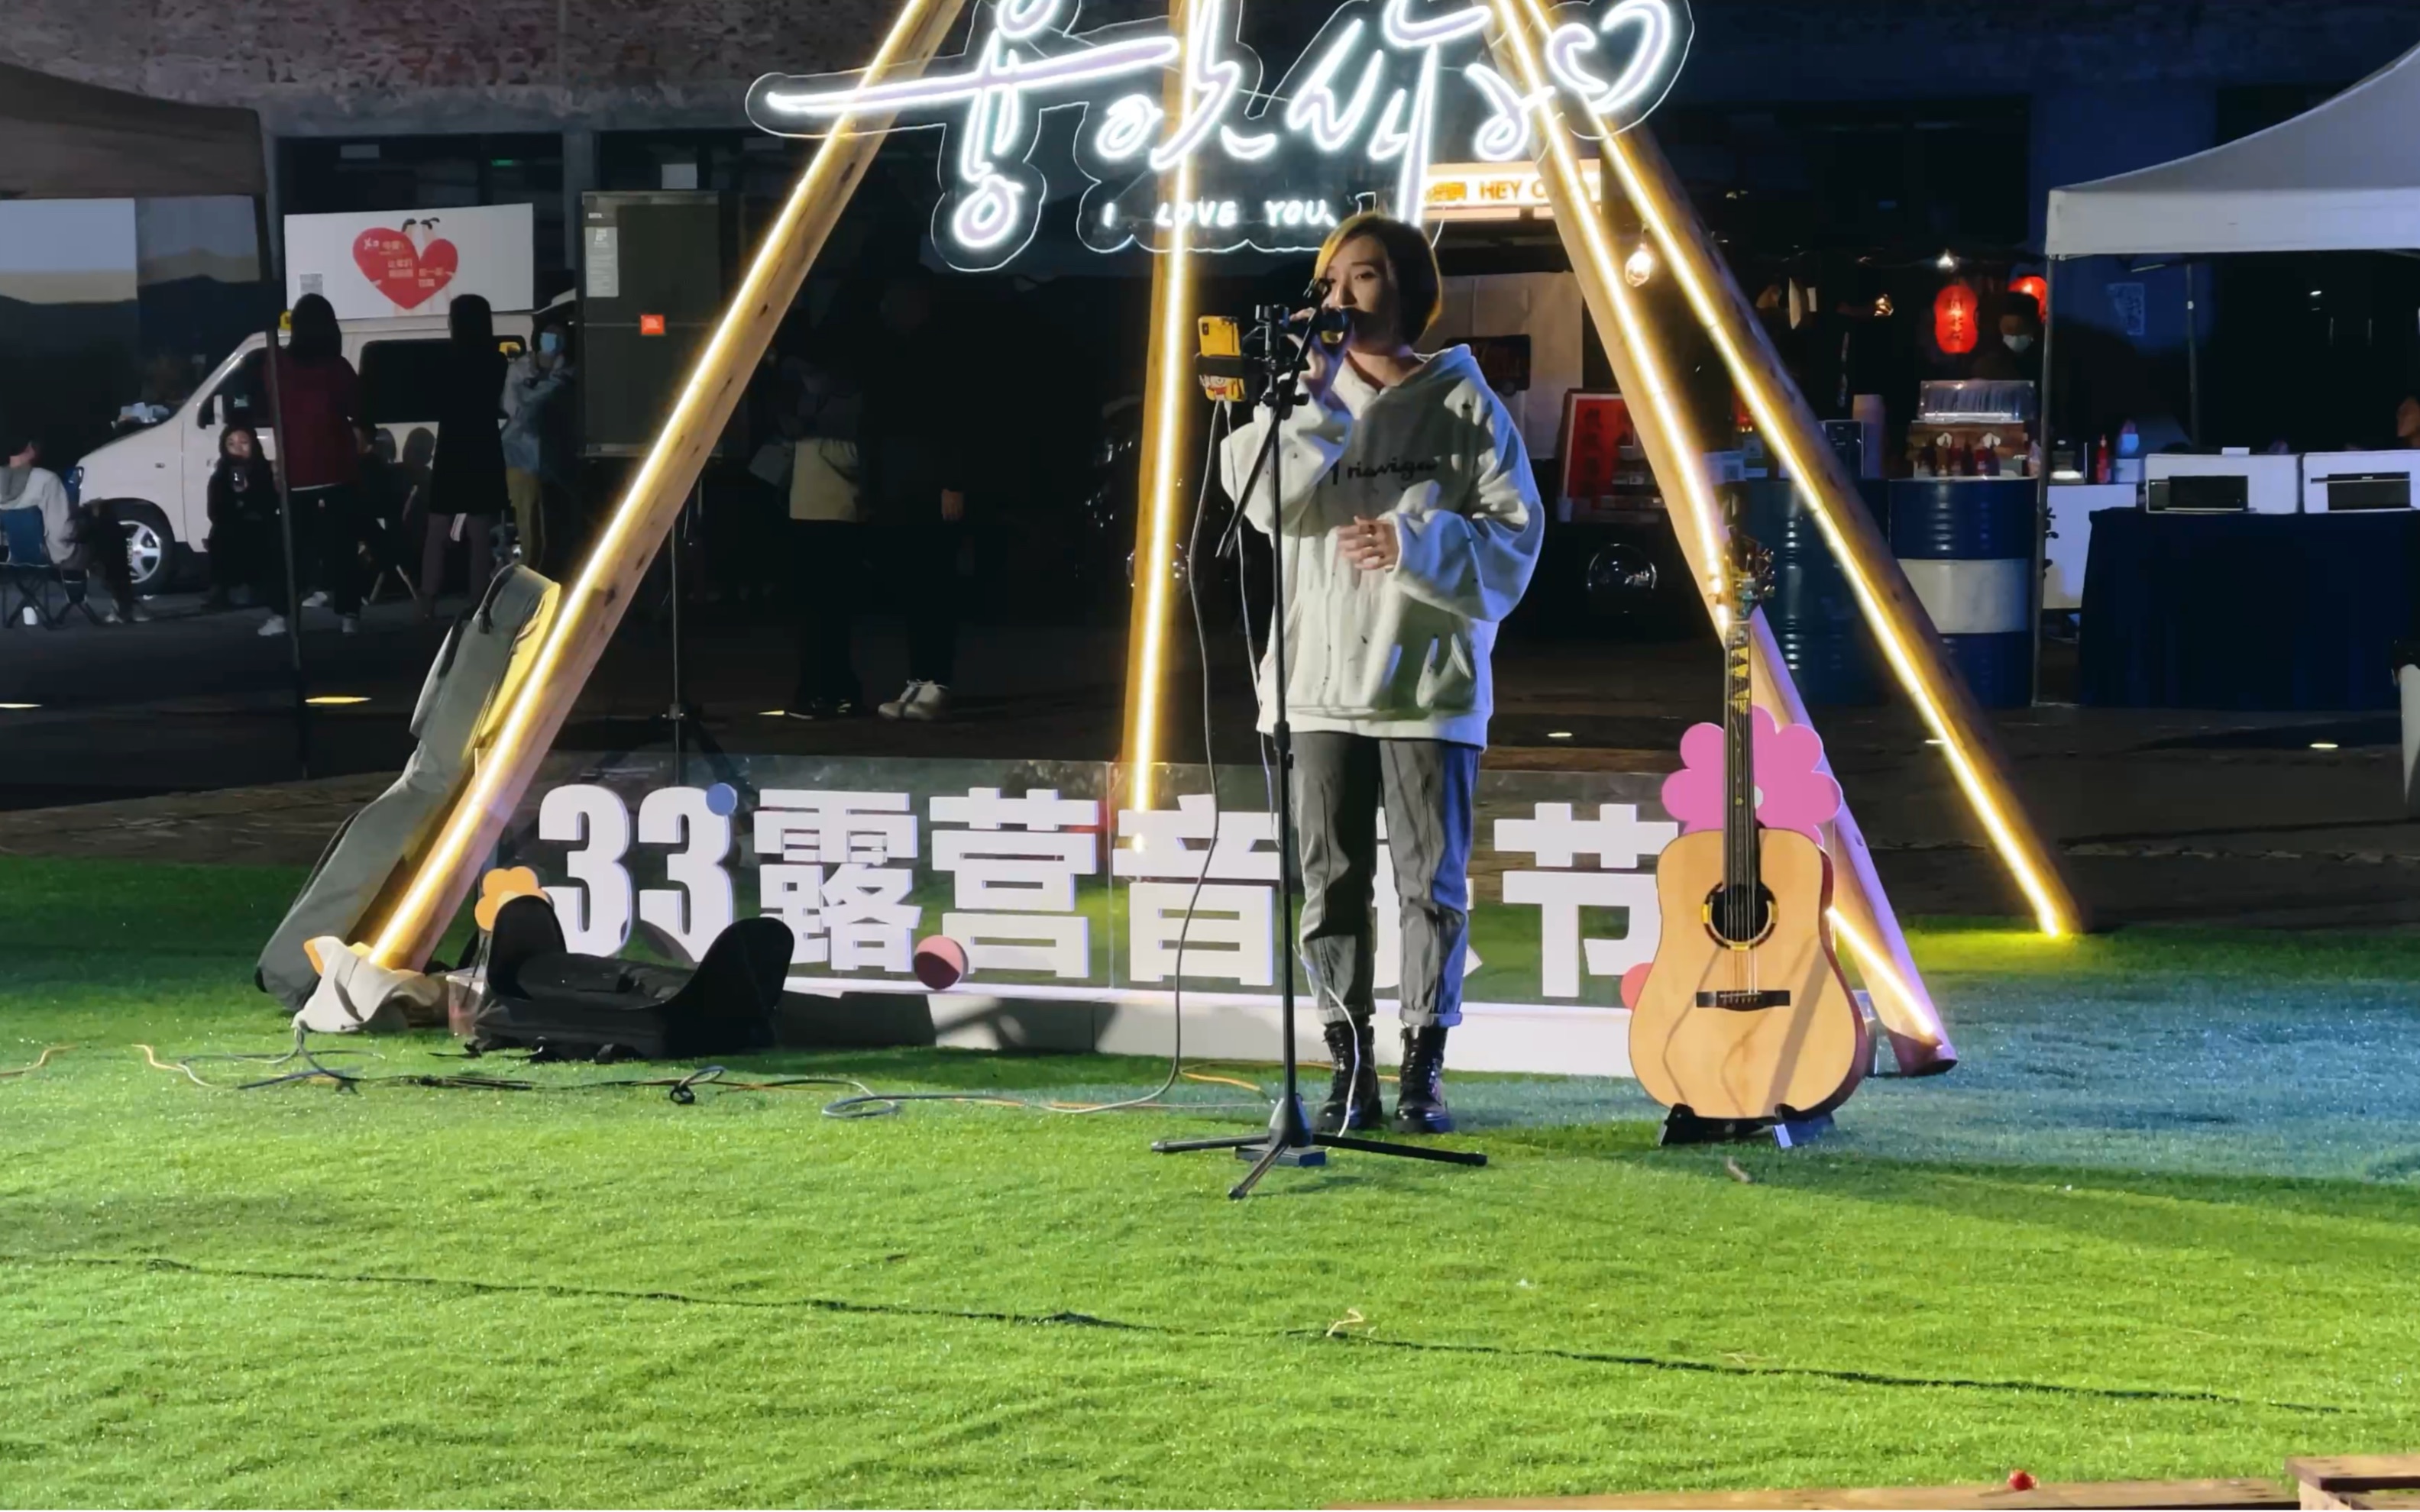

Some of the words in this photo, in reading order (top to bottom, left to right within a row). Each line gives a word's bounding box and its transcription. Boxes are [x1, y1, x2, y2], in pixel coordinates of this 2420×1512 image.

[1480, 179, 1522, 200] HEY
[1102, 201, 1115, 228] I
[1154, 200, 1239, 228] LOVE
[539, 783, 1678, 998] 33露营音节
